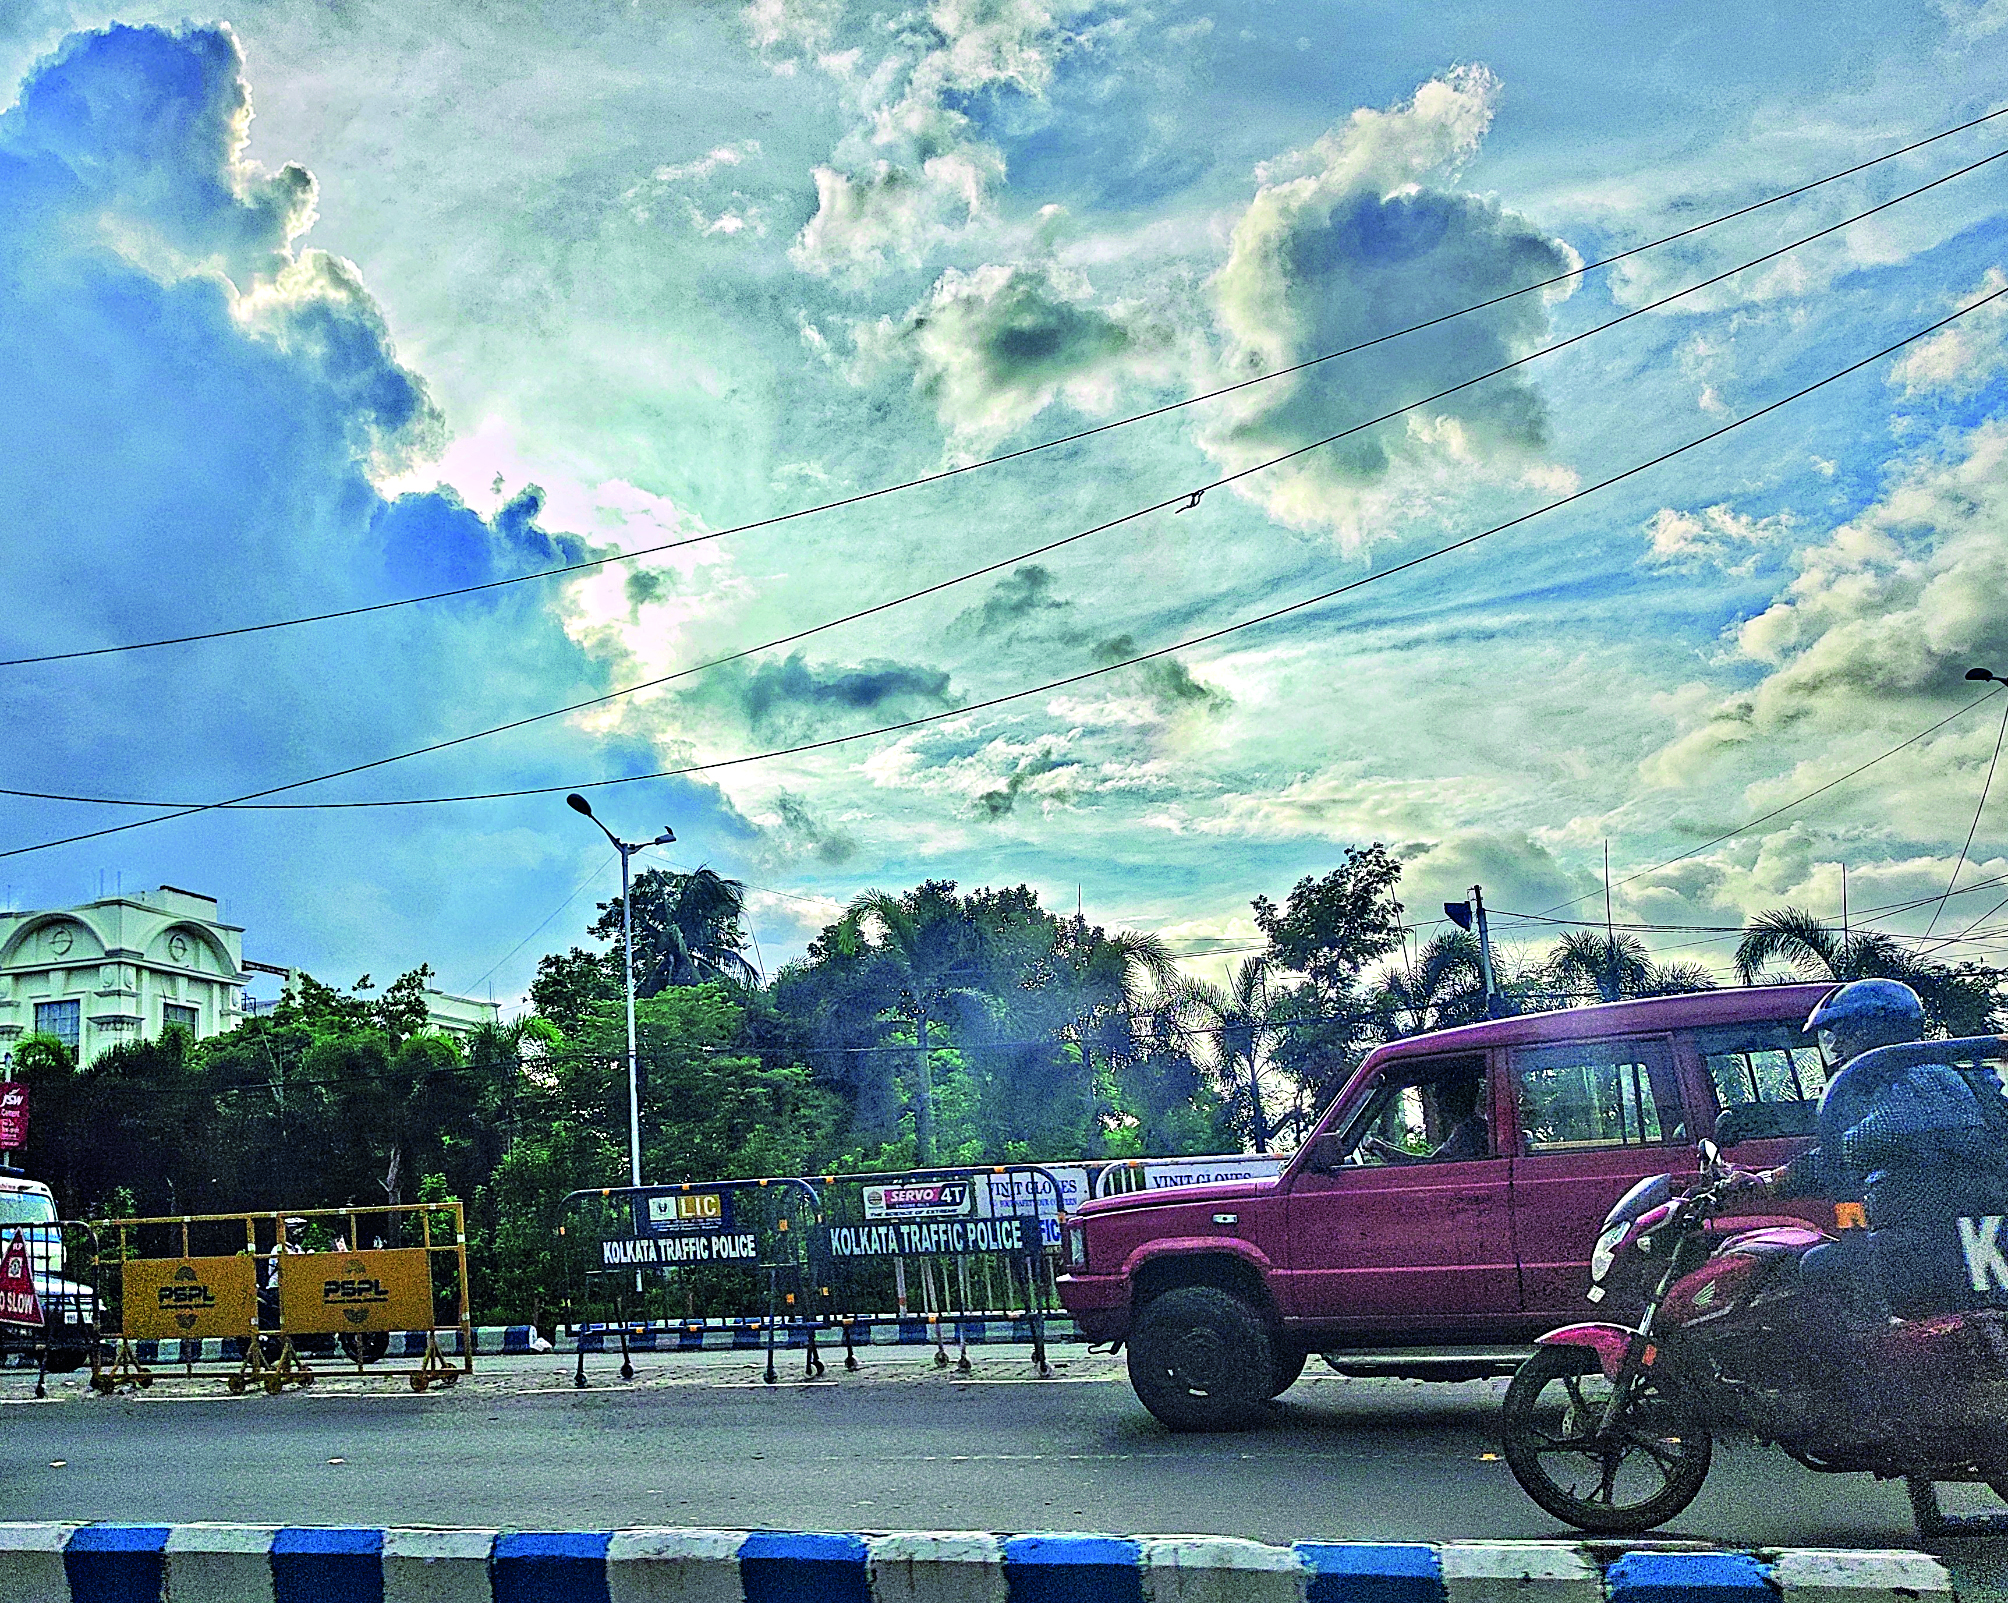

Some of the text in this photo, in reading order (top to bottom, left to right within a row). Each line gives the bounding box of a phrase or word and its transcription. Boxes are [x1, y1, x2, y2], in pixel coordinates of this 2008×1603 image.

[986, 1180, 1077, 1197] VINT GLOES
[1153, 1175, 1193, 1188] VINIT
[890, 1187, 963, 1203] SERVO 4T
[680, 1196, 717, 1217] LIC
[830, 1220, 1023, 1256] KOLKATA TRAFFIC POLICE
[602, 1234, 757, 1264] KOLKATA TRAFFIC POLICE
[158, 1286, 216, 1303] PSPL
[323, 1279, 389, 1298] PSPL
[7, 1291, 34, 1314] SLOW
